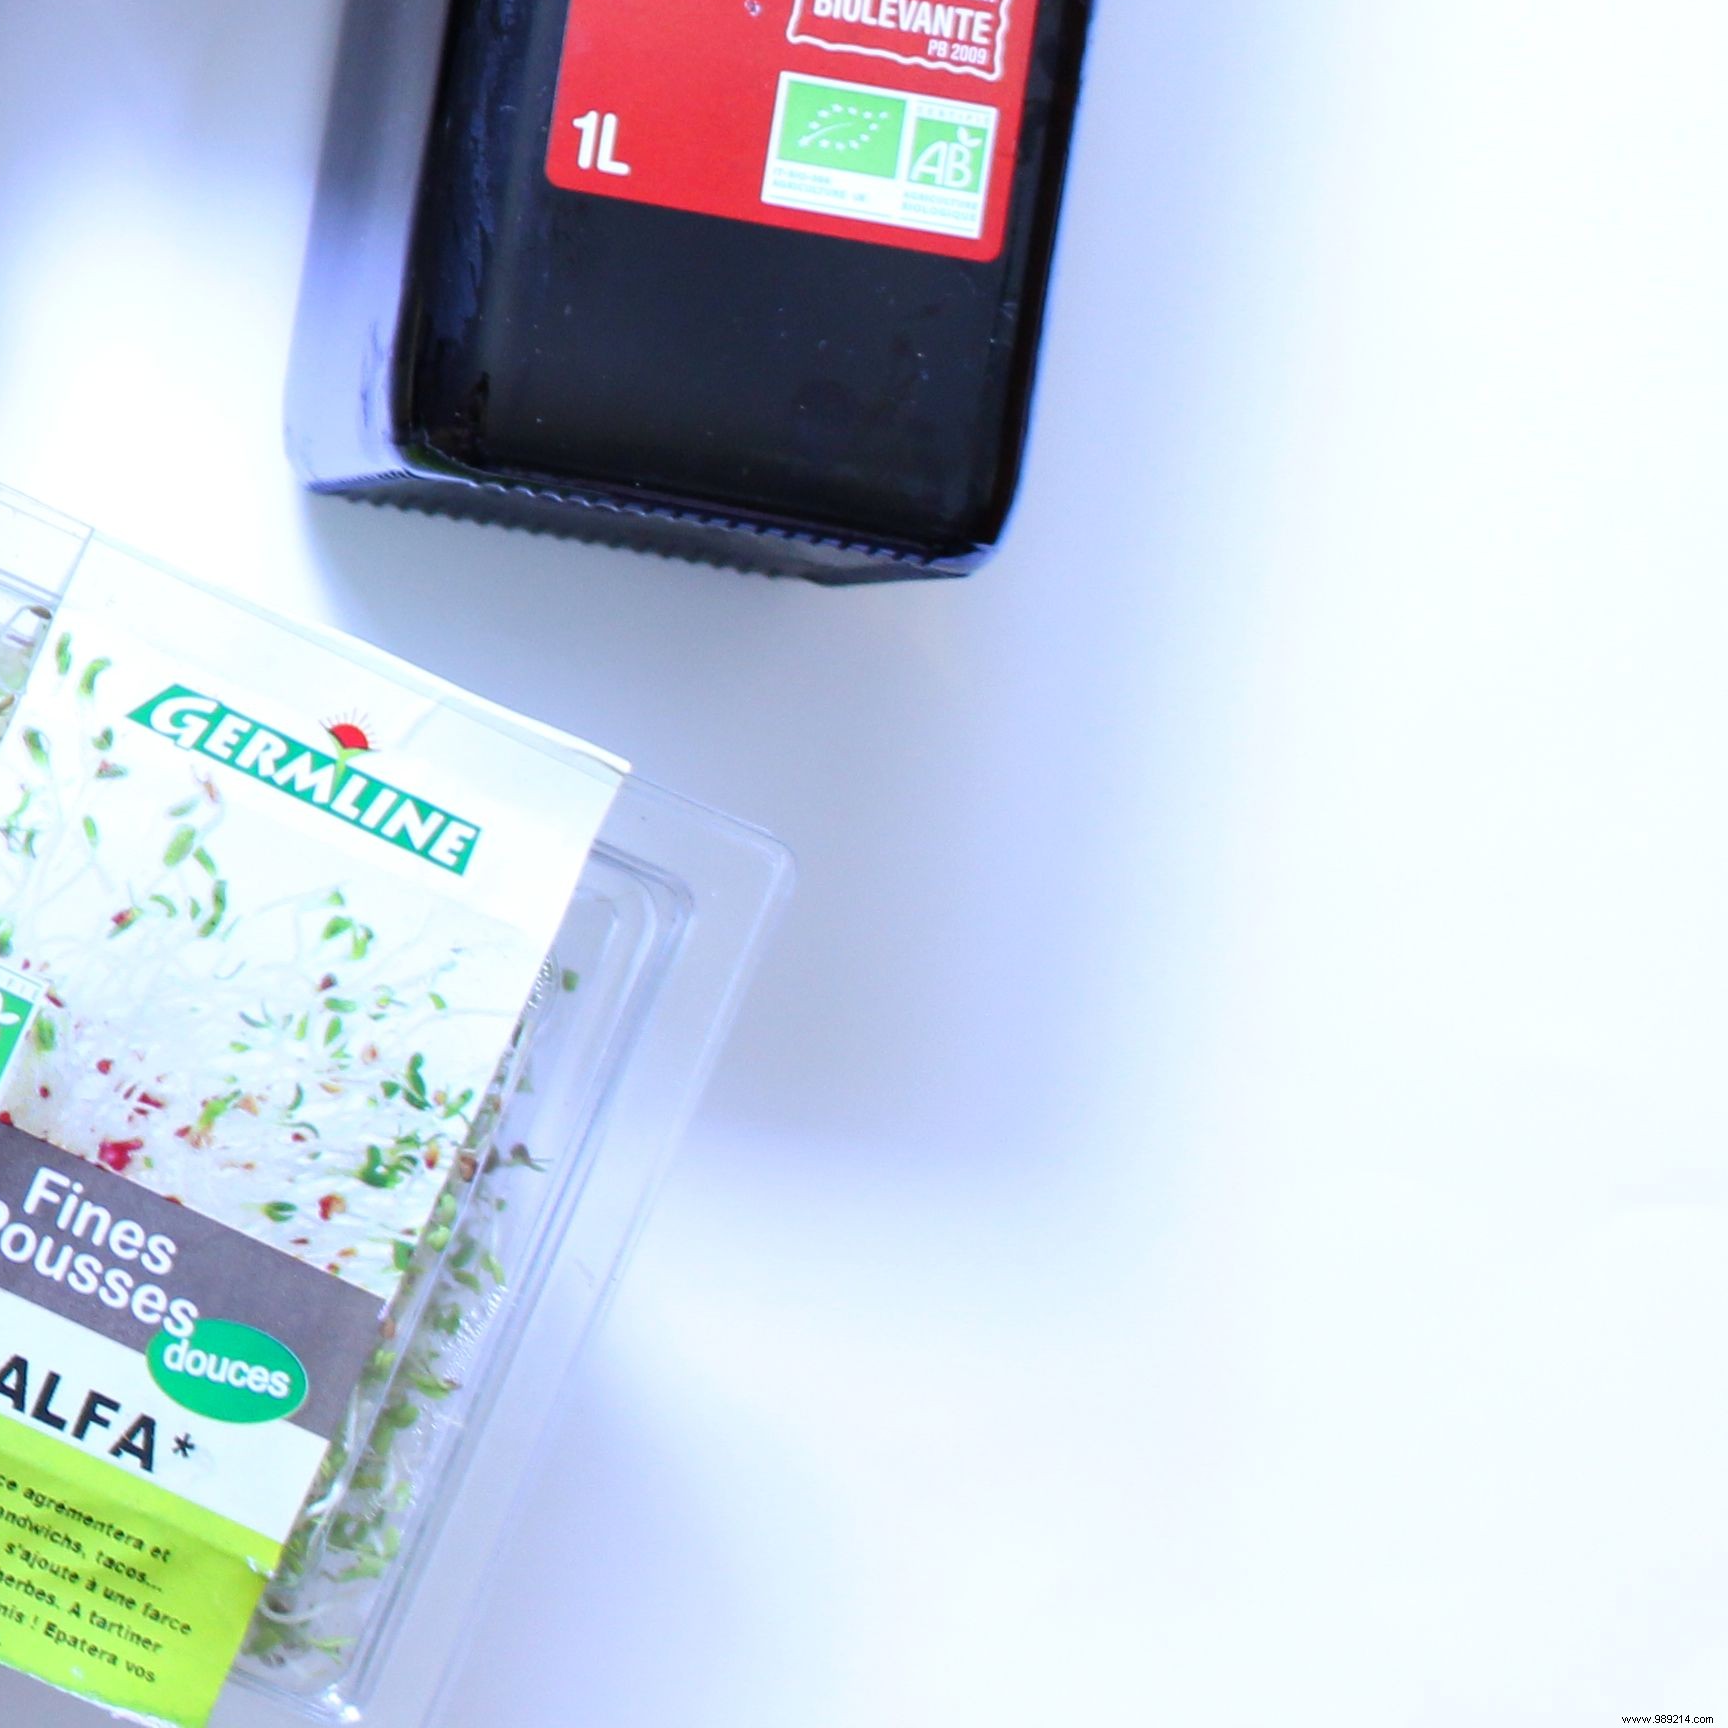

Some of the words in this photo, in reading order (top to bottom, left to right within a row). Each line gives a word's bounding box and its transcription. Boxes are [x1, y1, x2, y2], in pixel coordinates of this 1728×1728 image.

[950, 43, 990, 65] 2009
[572, 109, 632, 177] 1L
[909, 139, 973, 188] AB
[149, 696, 480, 868] GERMLINE
[23, 1166, 178, 1274] Fines
[162, 1338, 292, 1400] douces
[22, 1487, 145, 1551] agrémentera
[149, 1543, 172, 1564] et
[3, 1538, 80, 1586] s'ajoute
[84, 1576, 98, 1594] à
[102, 1585, 137, 1611] une
[142, 1602, 192, 1636] farce
[43, 1620, 119, 1666] Epatera
[124, 1658, 156, 1684] vos
[67, 1600, 82, 1619] A
[89, 1609, 164, 1654] tartiner
